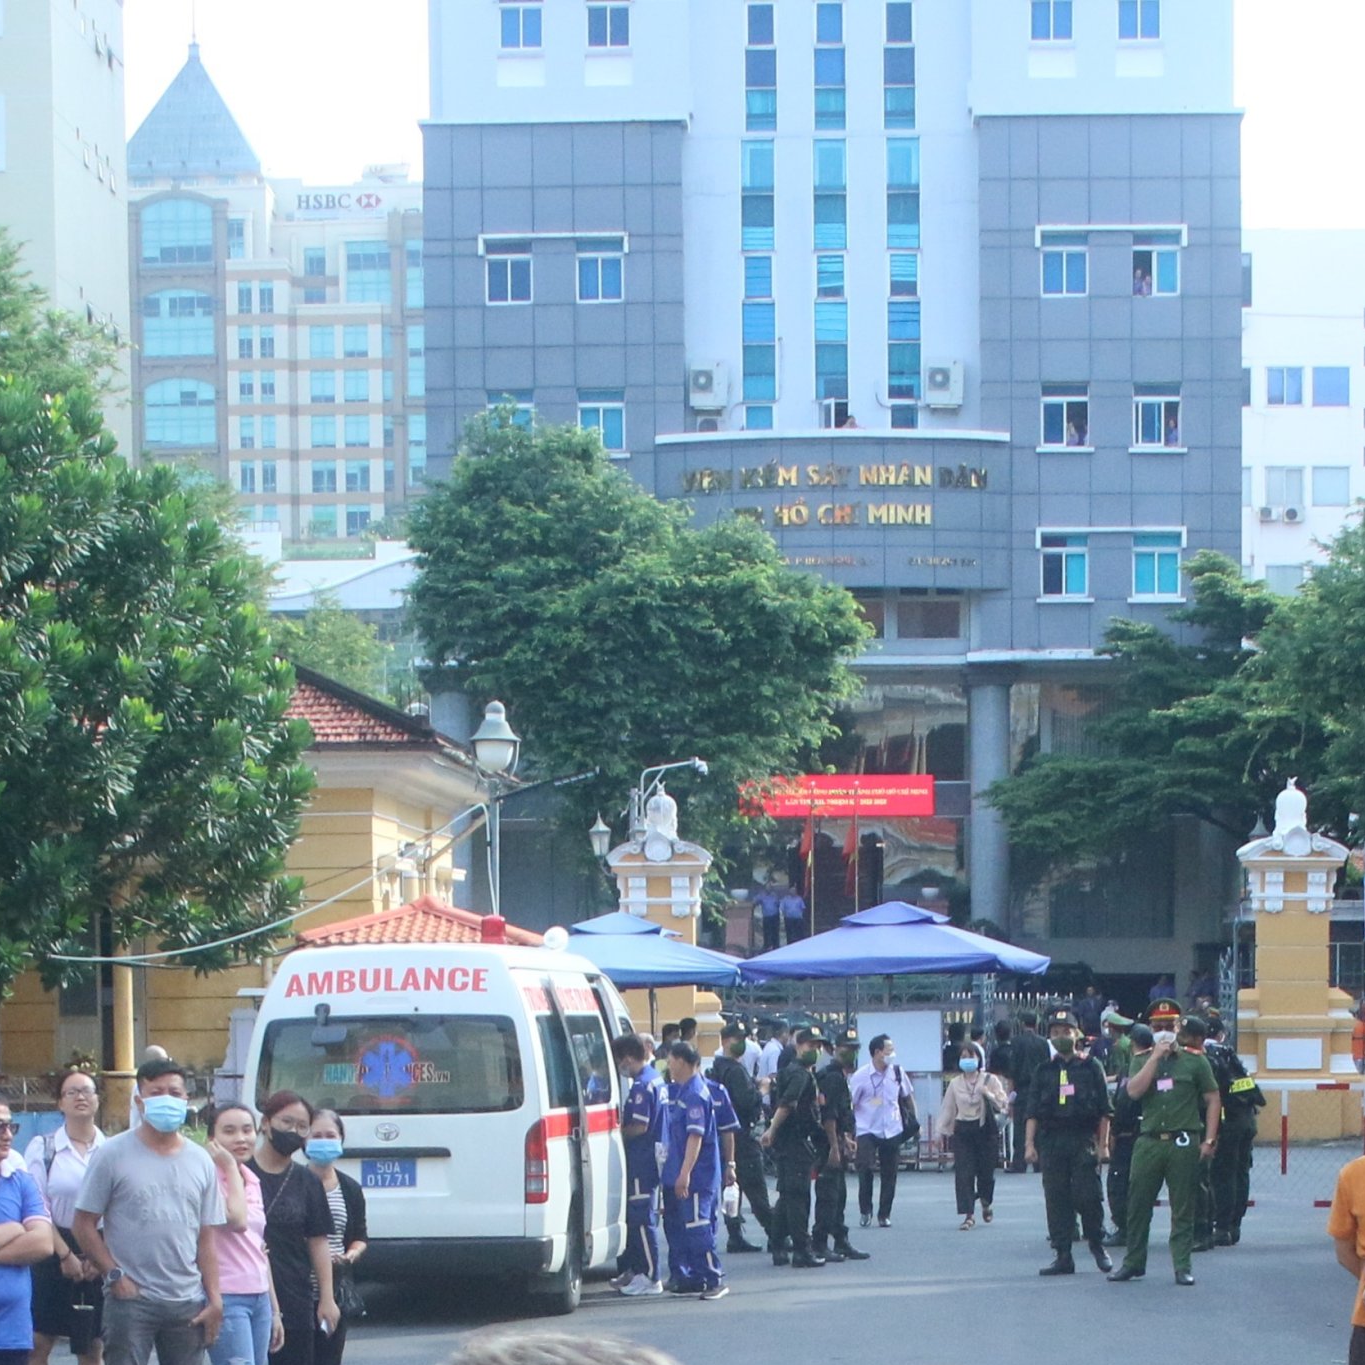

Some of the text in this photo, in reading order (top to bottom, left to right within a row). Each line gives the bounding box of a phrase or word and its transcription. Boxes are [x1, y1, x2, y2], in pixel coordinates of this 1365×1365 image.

[296, 193, 352, 211] HSBC
[858, 459, 933, 487] NHÂN
[867, 503, 933, 525] MINH
[284, 966, 490, 998] AMBULANCE
[376, 1161, 401, 1173] 50A
[367, 1174, 410, 1186] 017.71
